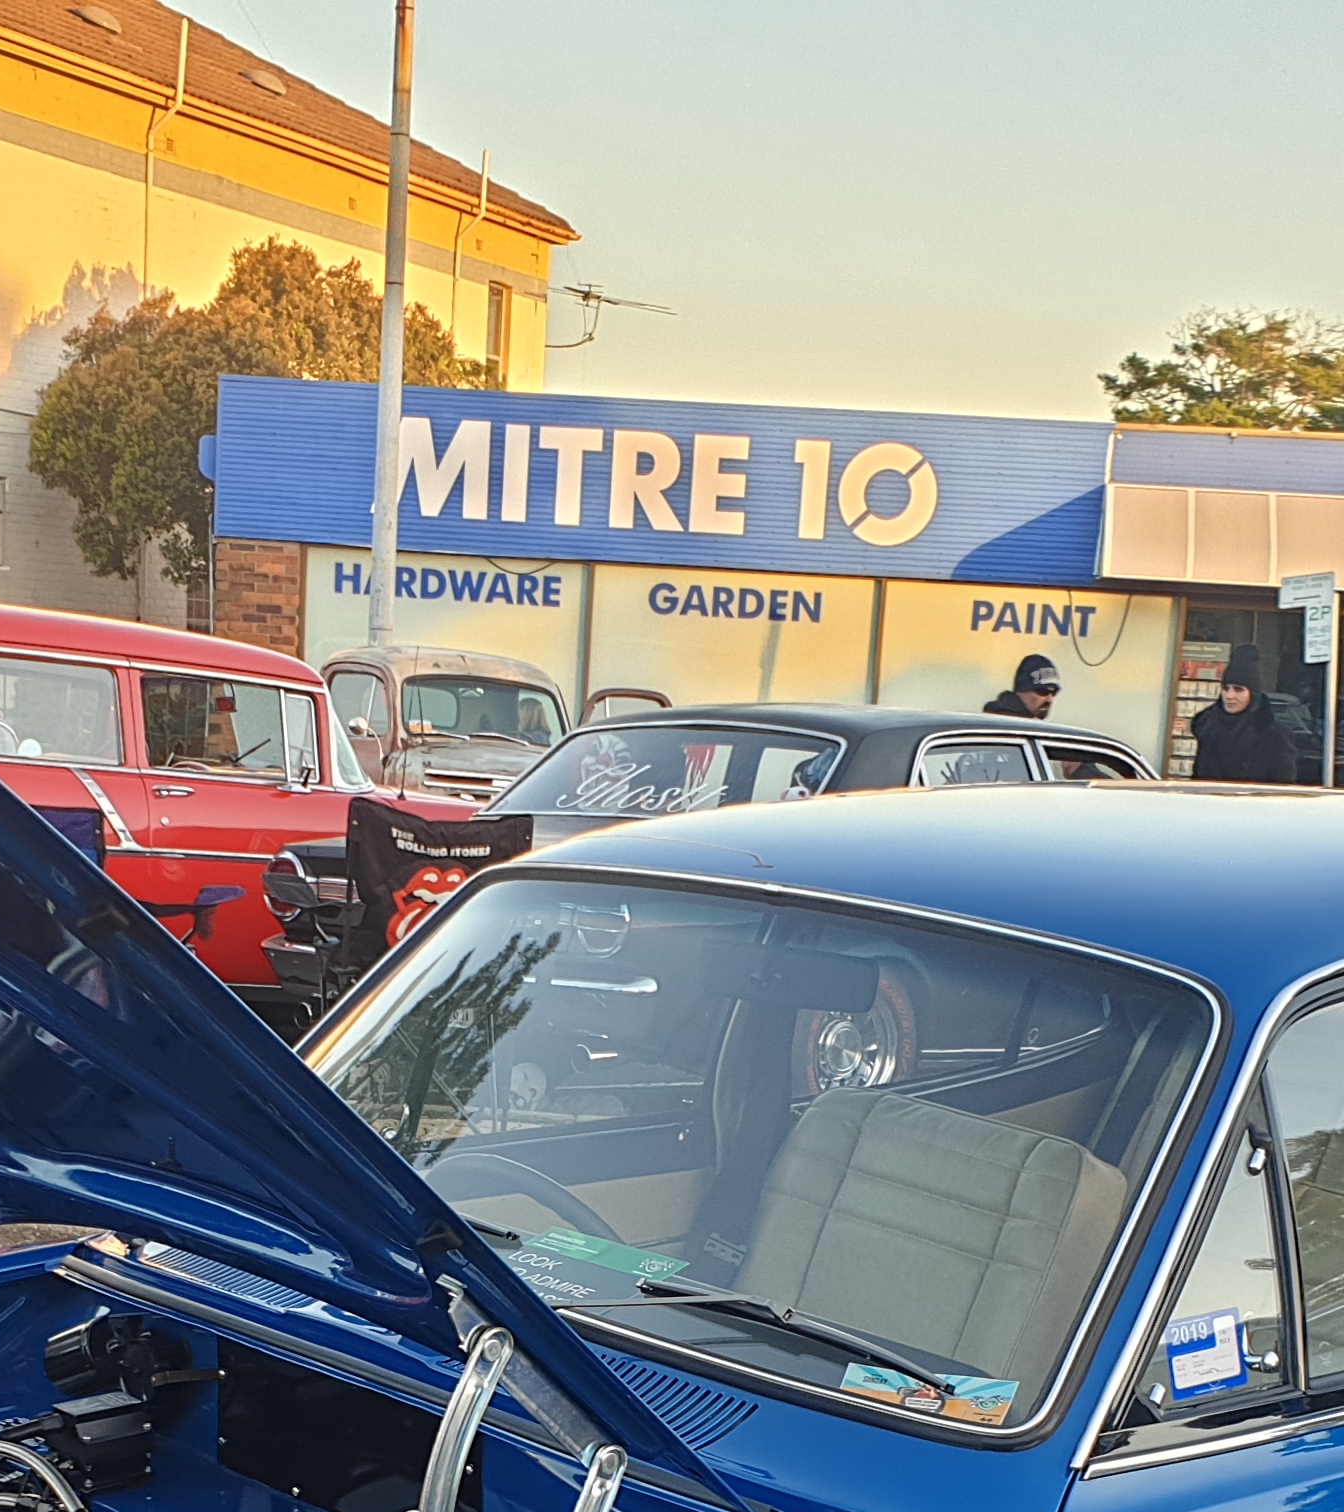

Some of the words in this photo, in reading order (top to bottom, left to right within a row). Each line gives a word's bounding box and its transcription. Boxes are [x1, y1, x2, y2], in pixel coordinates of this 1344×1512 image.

[370, 415, 750, 536] MITRE
[792, 437, 940, 547] 10
[334, 562, 562, 607] HRDWARE
[647, 582, 823, 624] GARDEN
[1308, 605, 1331, 621] 2P
[969, 599, 1097, 638] PAINT
[396, 838, 448, 858] ROLLING
[449, 845, 491, 858] STONES
[508, 1250, 564, 1271] LOOK
[522, 1273, 596, 1299] ADMIRE
[1170, 1321, 1208, 1347] 2019
